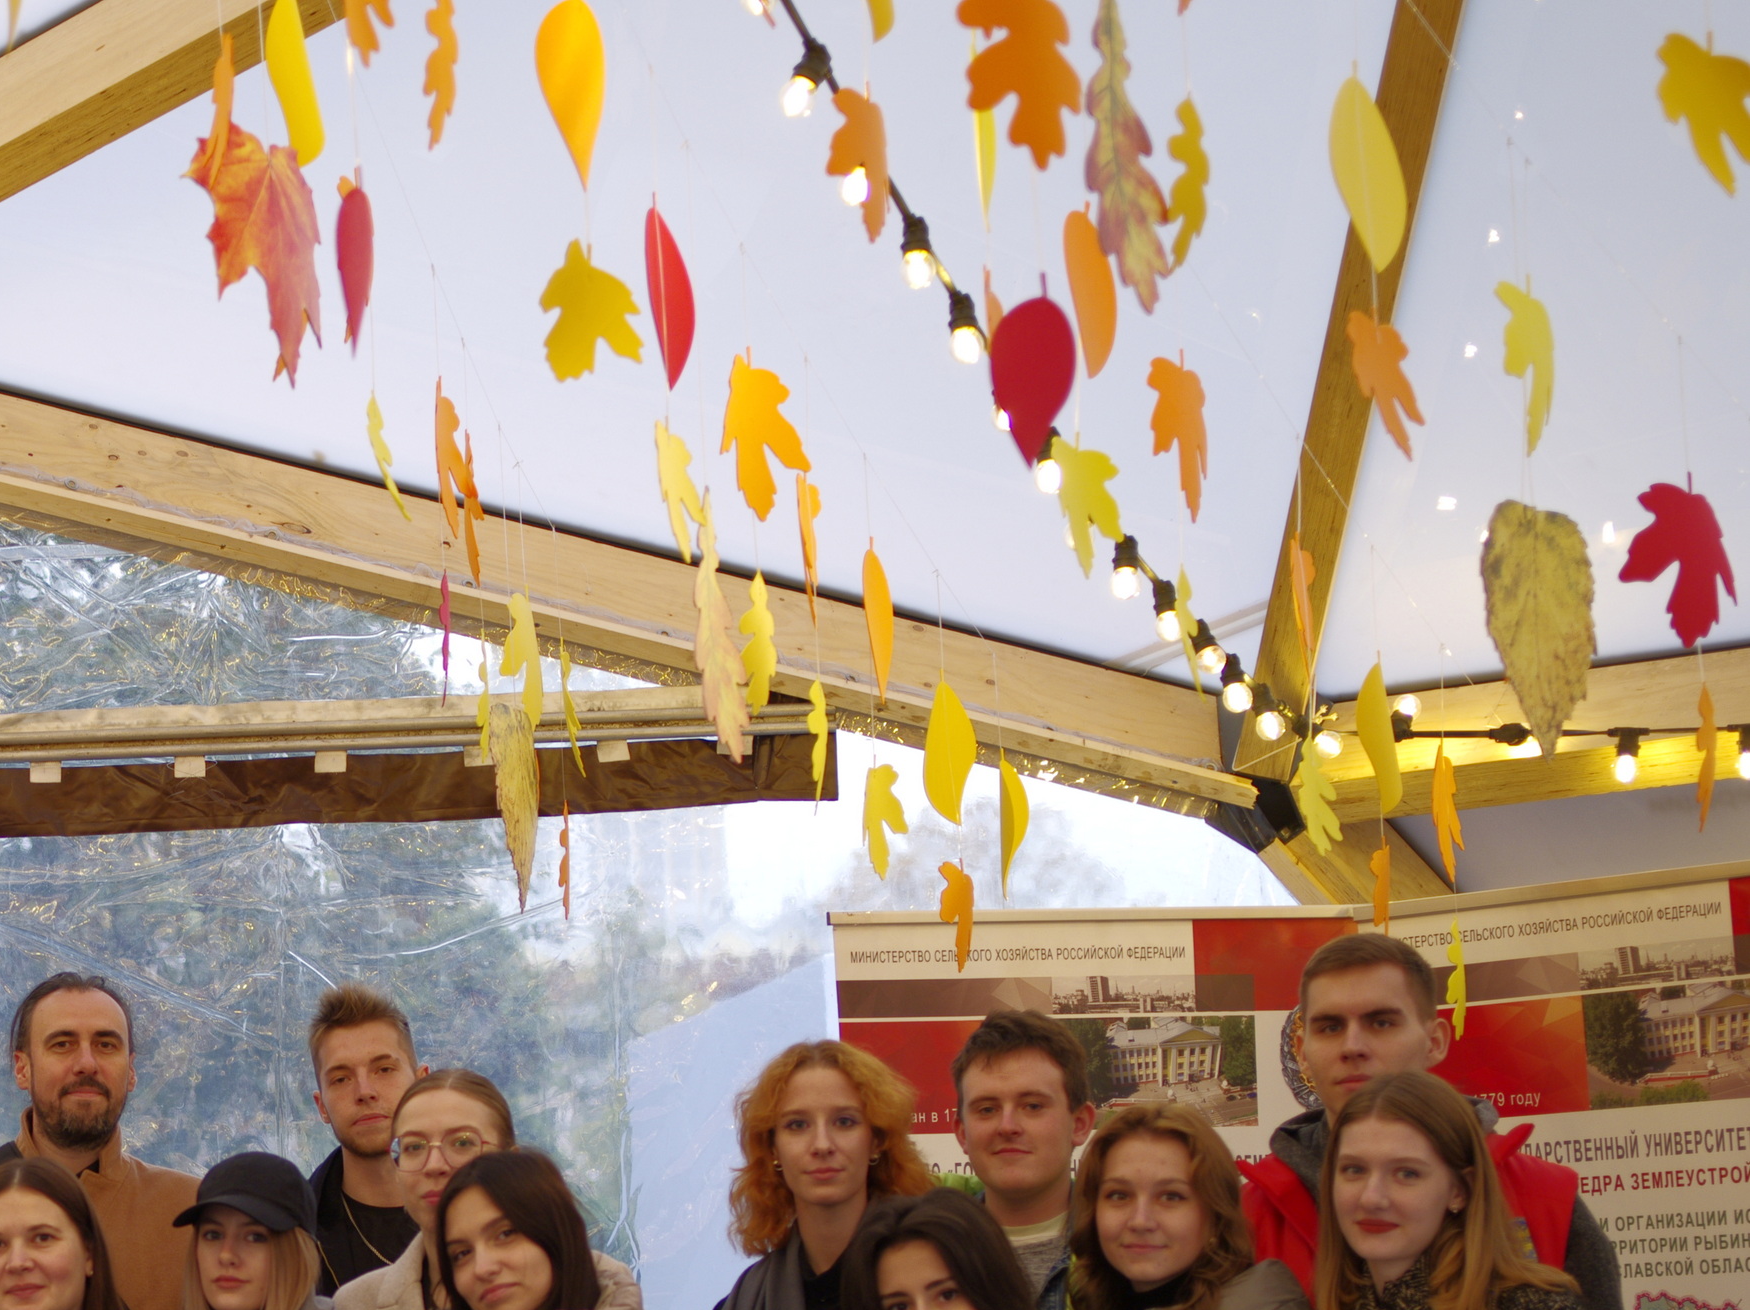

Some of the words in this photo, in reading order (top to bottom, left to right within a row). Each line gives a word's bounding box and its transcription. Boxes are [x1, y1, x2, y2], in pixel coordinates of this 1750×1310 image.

[1401, 931, 1453, 949] СТЕРСТВО
[1518, 918, 1579, 937] ХОЗЯЙСТВА
[1581, 907, 1654, 929] РОССИЙСКОЙ
[1656, 901, 1722, 921] ФЕДЕРАЦИИ
[850, 949, 931, 964] МИНИСТЕРСТВО
[934, 949, 992, 962] СЕЛЬКОГО
[995, 946, 1054, 961] ХОЗЯЙСТВА
[1056, 944, 1124, 960] РОССИЙСКОЙ
[1126, 946, 1186, 961] ФЕДЕРАЦИИ
[1510, 1092, 1541, 1107] году
[1519, 1129, 1640, 1166] ДАРСТВЕННЫЙ
[1580, 1174, 1625, 1196] ЕДРА
[1615, 1210, 1728, 1232] ОРГАНИЗАЦИИ
[1620, 1257, 1693, 1278] ЛАВСКОЙ
